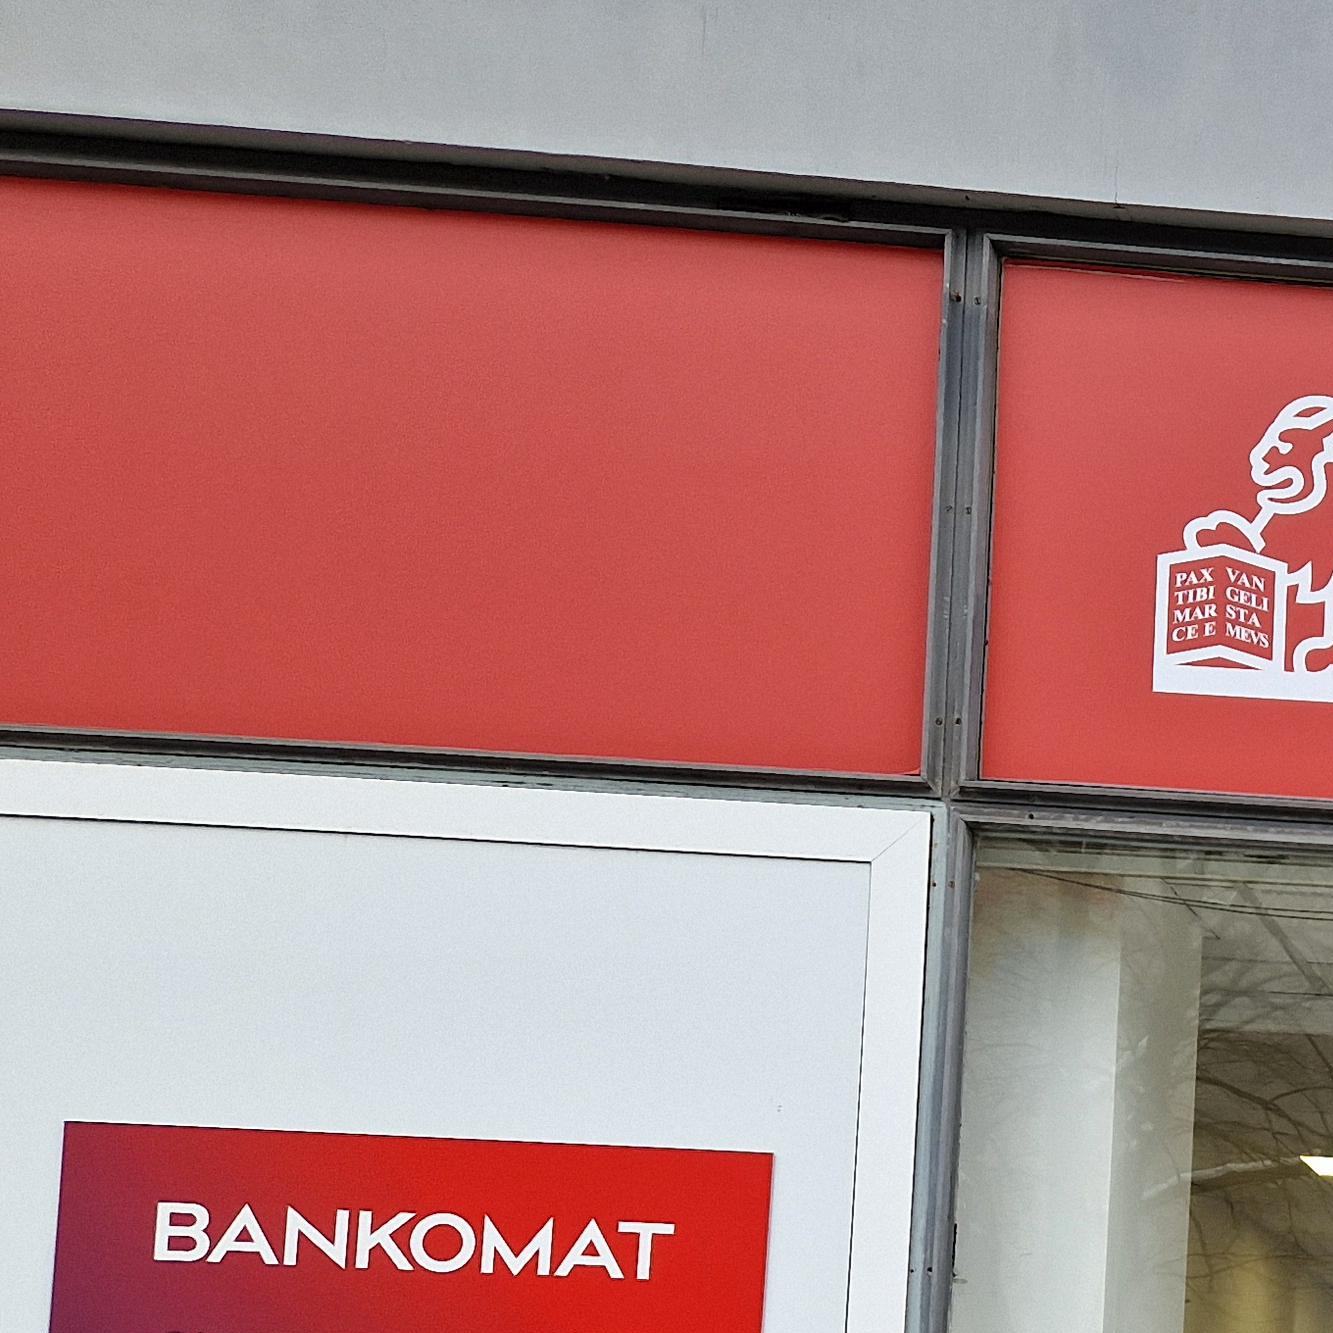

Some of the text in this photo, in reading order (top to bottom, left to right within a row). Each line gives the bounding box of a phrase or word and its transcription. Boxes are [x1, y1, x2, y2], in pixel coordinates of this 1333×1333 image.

[1175, 567, 1215, 588] PAX
[1225, 566, 1265, 593] VAN
[1174, 585, 1216, 605] TIBI
[1225, 586, 1269, 612] GELI
[1172, 603, 1218, 625] MAR
[1225, 604, 1262, 628] STA
[1172, 621, 1216, 642] CE E
[1225, 621, 1270, 649] MEVS
[152, 1200, 676, 1281] BANKOMAT
